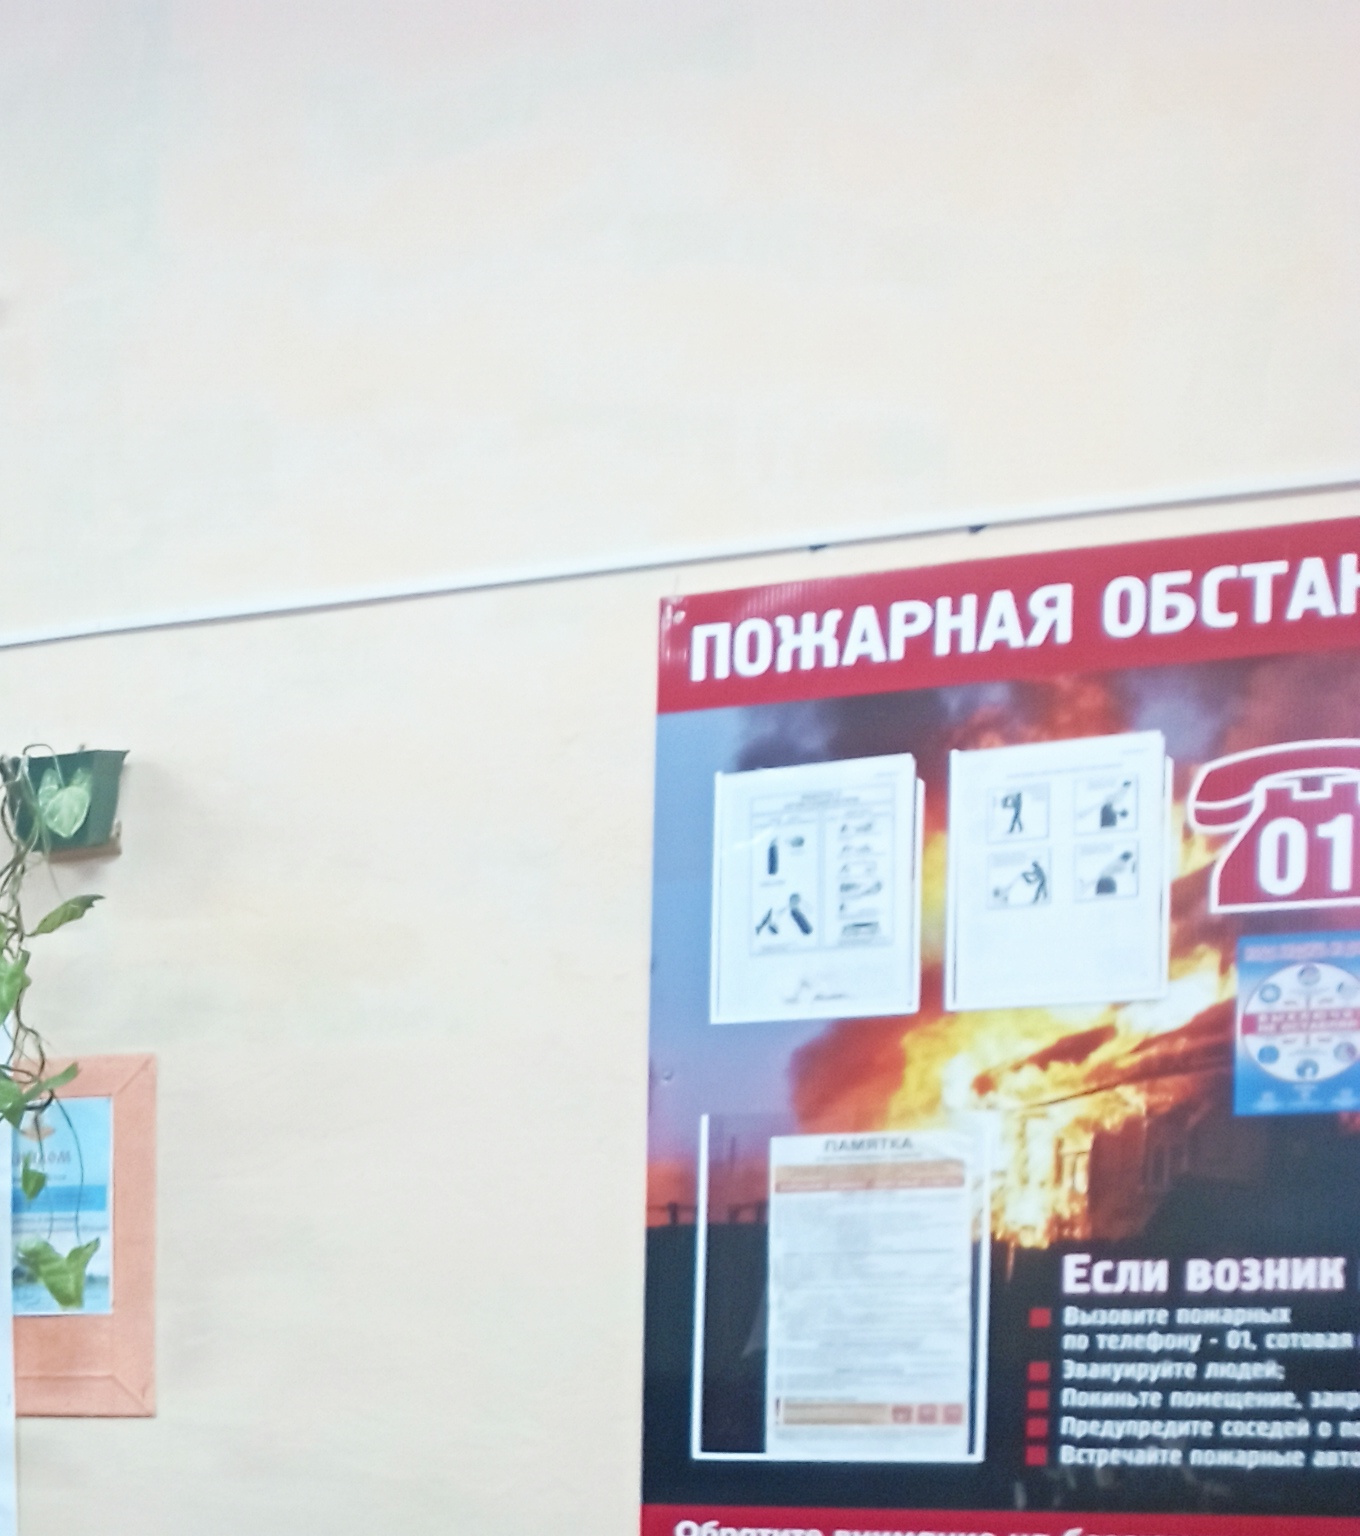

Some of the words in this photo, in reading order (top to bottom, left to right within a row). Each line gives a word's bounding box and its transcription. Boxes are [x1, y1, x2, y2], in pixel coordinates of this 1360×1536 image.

[690, 582, 1073, 682] ПОЖАРНАЯ
[1259, 813, 1353, 896] 01
[1063, 1306, 1169, 1326] Вызовите
[1095, 1331, 1202, 1353] телефону
